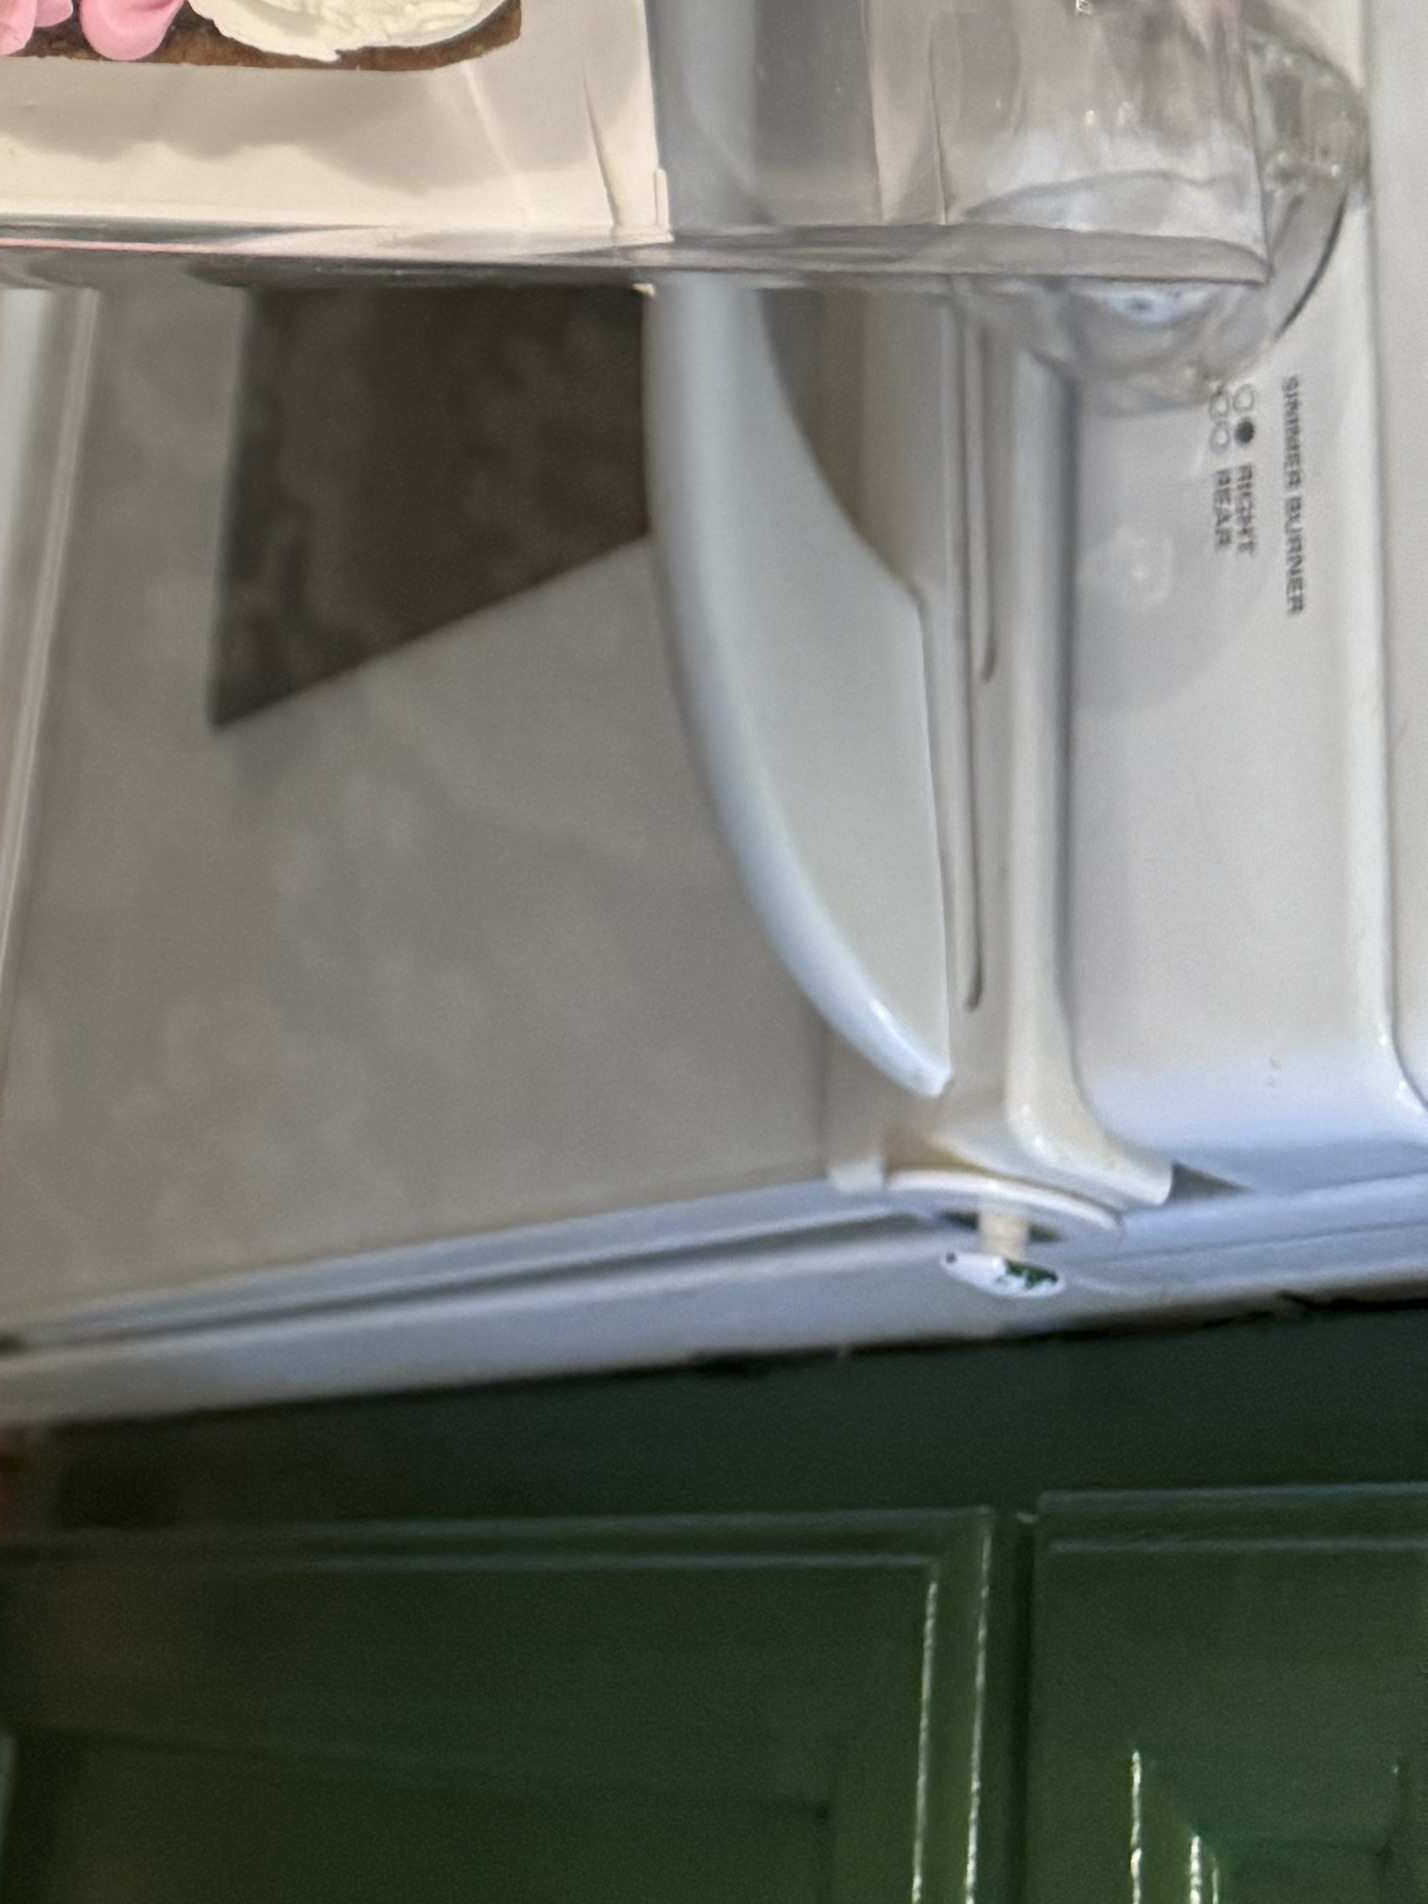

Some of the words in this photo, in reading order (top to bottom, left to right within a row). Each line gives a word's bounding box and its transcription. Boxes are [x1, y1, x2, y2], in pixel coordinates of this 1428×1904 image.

[1213, 468, 1232, 553] REAR
[1235, 463, 1257, 556] RIGHT
[1284, 495, 1305, 616] BURNER
